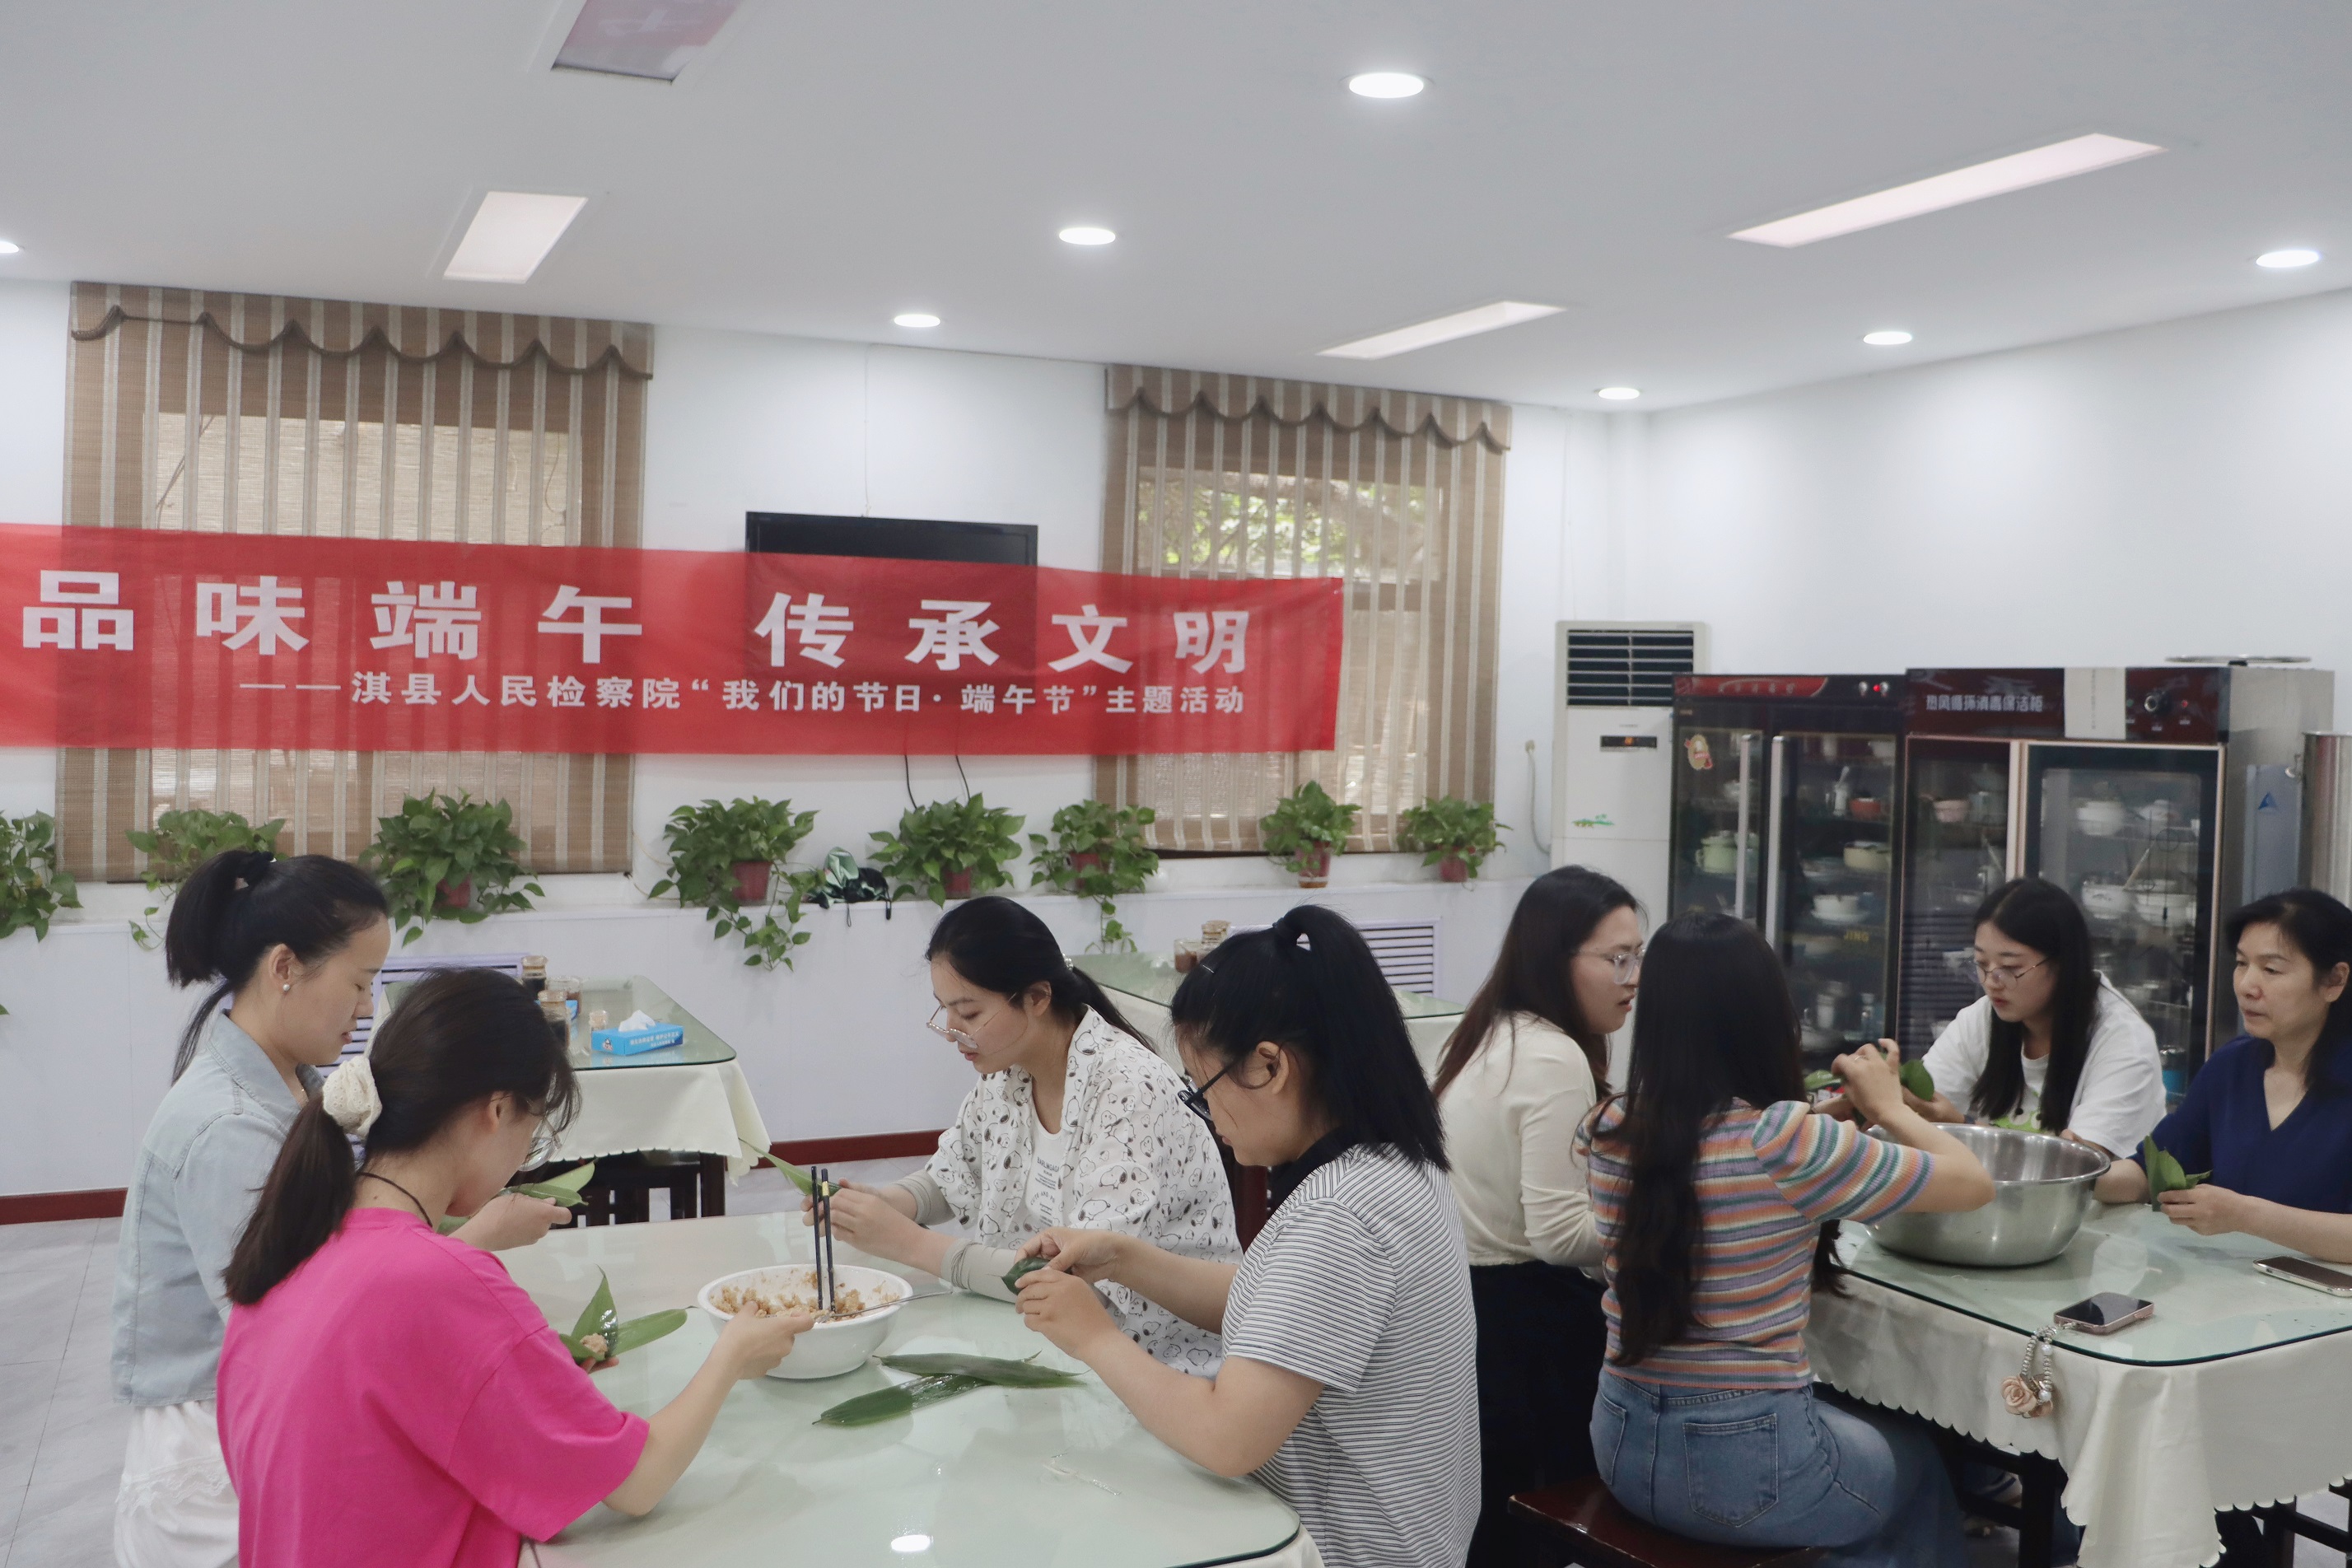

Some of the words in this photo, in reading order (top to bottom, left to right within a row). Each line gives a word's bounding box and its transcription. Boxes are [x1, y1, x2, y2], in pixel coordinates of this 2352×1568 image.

[22, 569, 642, 664] 品味端午
[754, 591, 1249, 674] 传承文明
